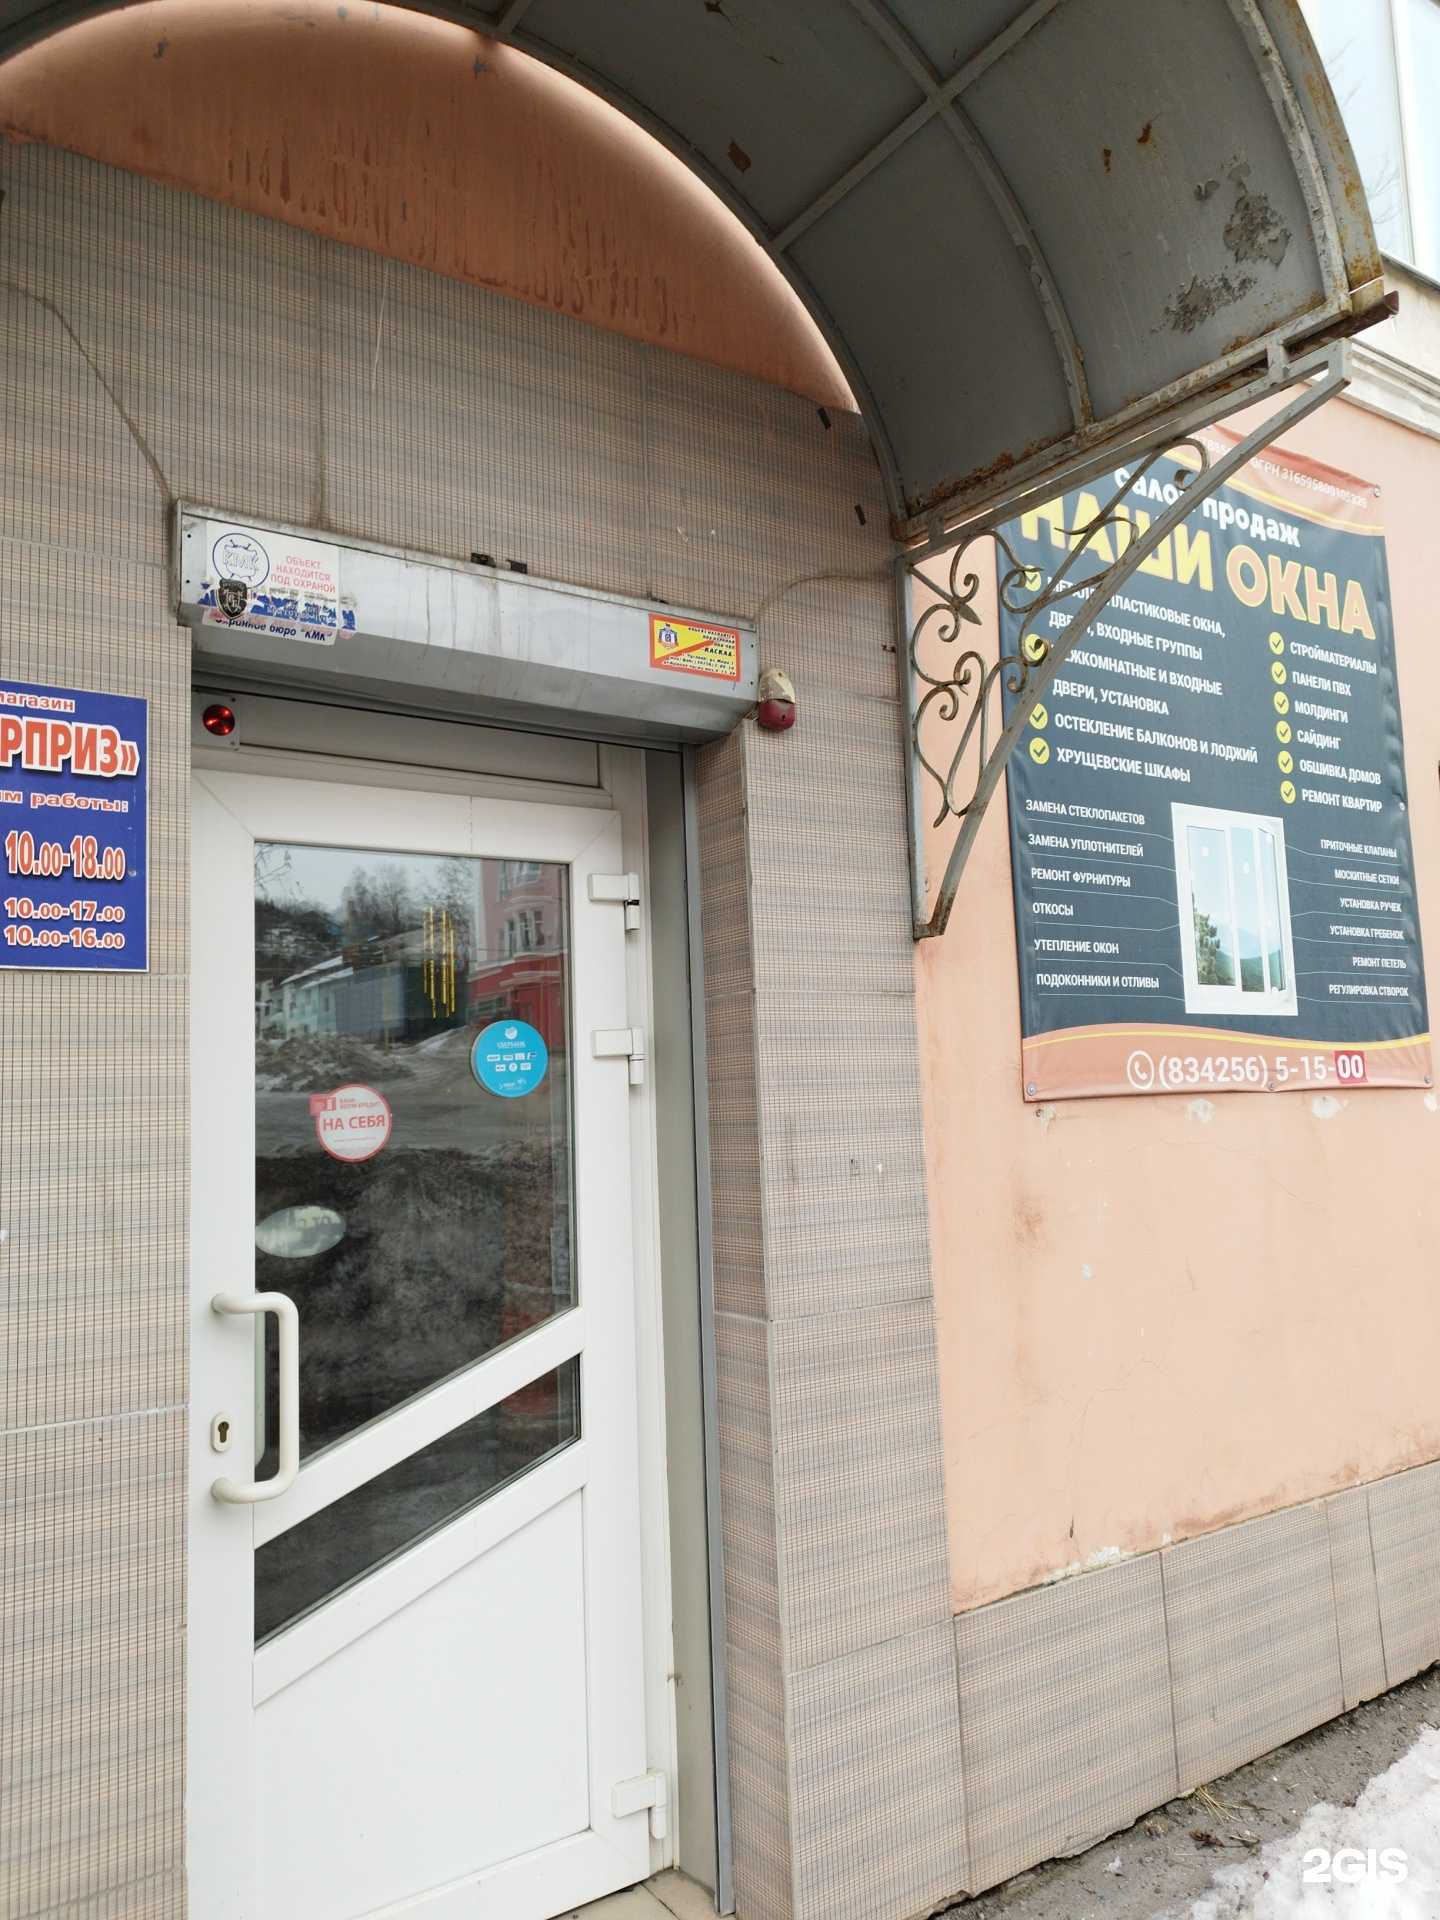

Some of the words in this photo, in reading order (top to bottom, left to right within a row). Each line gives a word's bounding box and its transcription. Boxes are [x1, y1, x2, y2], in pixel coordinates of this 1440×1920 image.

[1114, 467, 1186, 506] сало
[1203, 499, 1301, 547] продаж
[276, 564, 332, 581] НАХОДИТСЯ
[286, 555, 321, 570] ОБЪЕКТ
[1020, 491, 1215, 592] НАШИ
[1226, 543, 1377, 641] ОКНА
[270, 574, 291, 586] ПОД
[293, 577, 336, 593] ОХРАНОЙ
[1049, 611, 1095, 637] ДВЕ,
[1097, 622, 1154, 649] ВХОДНЫЕ
[1156, 637, 1203, 660] ГРУППЫ
[1193, 616, 1226, 638] ОКНА,
[1290, 641, 1377, 675] СТРОЙМАТЕРИАЛЫ
[1056, 646, 1157, 681] ЖКОМНАТНЫЕ
[1158, 670, 1168, 683] И
[1170, 672, 1223, 696] ВХОДНЫЕ
[1292, 671, 1332, 691] ПАНЕЛИ
[1333, 680, 1352, 696] ПВХ
[1053, 678, 1098, 703] ДВЕРИ,
[1100, 689, 1170, 715] УСТАНОВКА
[1294, 701, 1349, 723] МОЛДИНГИ
[0, 713, 140, 778] РПРИЗ»
[1055, 713, 1134, 741] ОСТЕКЛЕНИЕ
[1136, 728, 1198, 752] БАЛКОНОВ
[1199, 739, 1209, 753] И
[1210, 742, 1258, 763] ЛОДЖИЙ
[1297, 729, 1341, 750] САЙДИНГ
[1057, 747, 1142, 774] ХРУЩЕВСКИЕ
[1144, 762, 1191, 783] ШКАФЫ
[1299, 759, 1347, 779] ОБШИВКА
[1348, 768, 1382, 785] ДОМОВ
[30, 792, 129, 813] работы:
[1026, 799, 1067, 815] ЗАМЕНА
[1068, 805, 1145, 825] СТЕКЛОПАКЕТОВ
[1302, 788, 1340, 806] РЕМОНТ
[1342, 795, 1382, 813] КВАРТИР
[5, 830, 125, 880] 10.00-18.00
[1028, 833, 1069, 849] ЗАМЕНА
[1070, 838, 1144, 857] УПЛОТНИТЕЛЕЙ
[1320, 839, 1363, 854] ПРИТОЧНЫЕ
[1364, 845, 1398, 858] КЛАПАНЫ
[1031, 867, 1072, 882] РЕМОНТ
[1072, 871, 1131, 888] ФУРНИТУРЫ
[1334, 869, 1378, 883] МОСКИТНЫЕ
[1378, 873, 1400, 886] СЕТКИ
[4, 897, 125, 922] 10.00-17.00
[1032, 902, 1074, 916] ОТКОСЫ
[1339, 897, 1379, 911] УСТАНОВКА
[1380, 901, 1402, 913] РУЧЕК
[4, 925, 125, 949] 10.00-16.00
[1329, 924, 1370, 938] УСТАНОВКА
[1370, 928, 1404, 940] ГРЕБЕНОК
[1034, 938, 1092, 953] УТЕПЛЕНИЕ
[1093, 942, 1119, 954] ОКОН
[1352, 956, 1381, 968] РЕМОНТ
[1381, 959, 1407, 969] ПЕТЕЛЬ
[1036, 973, 1111, 988] ПОДОКОННИКИ
[1112, 976, 1120, 987] И
[1121, 976, 1160, 989] ОТЛИВЫ
[1329, 984, 1378, 996] РЕГУЛИРОВКА
[1378, 985, 1409, 997] СТВОРОК
[1158, 1055, 1269, 1090] (834256)
[1275, 1053, 1364, 1082] 5-15-00
[323, 1117, 344, 1131] НА
[349, 1115, 385, 1129] СЕБЯ
